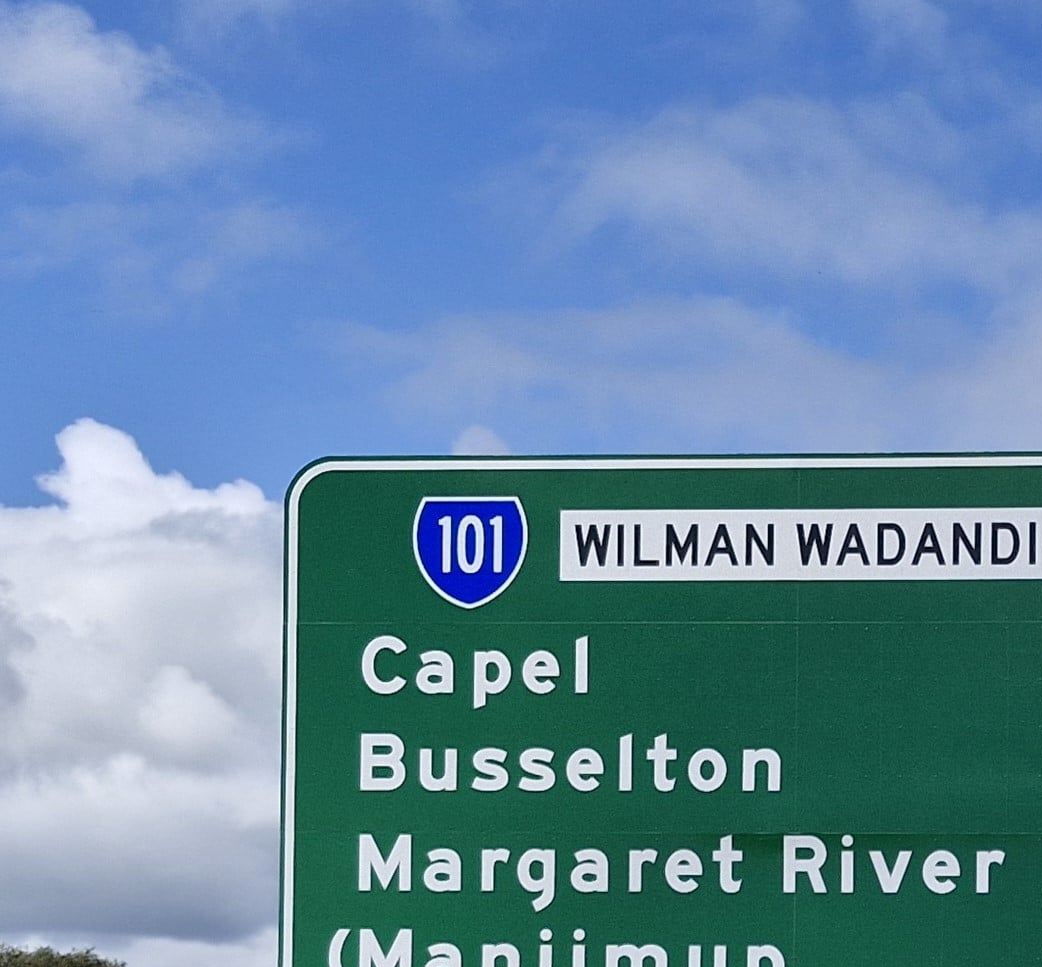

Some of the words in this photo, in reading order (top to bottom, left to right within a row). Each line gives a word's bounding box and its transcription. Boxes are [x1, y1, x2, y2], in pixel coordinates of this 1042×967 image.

[439, 515, 502, 573] 101
[575, 524, 774, 566] WILMAN
[797, 522, 1036, 565] WADANDI
[362, 636, 587, 708] Capel
[360, 734, 780, 791] Busselton
[359, 834, 742, 911] Margaret
[784, 835, 1005, 893] River
